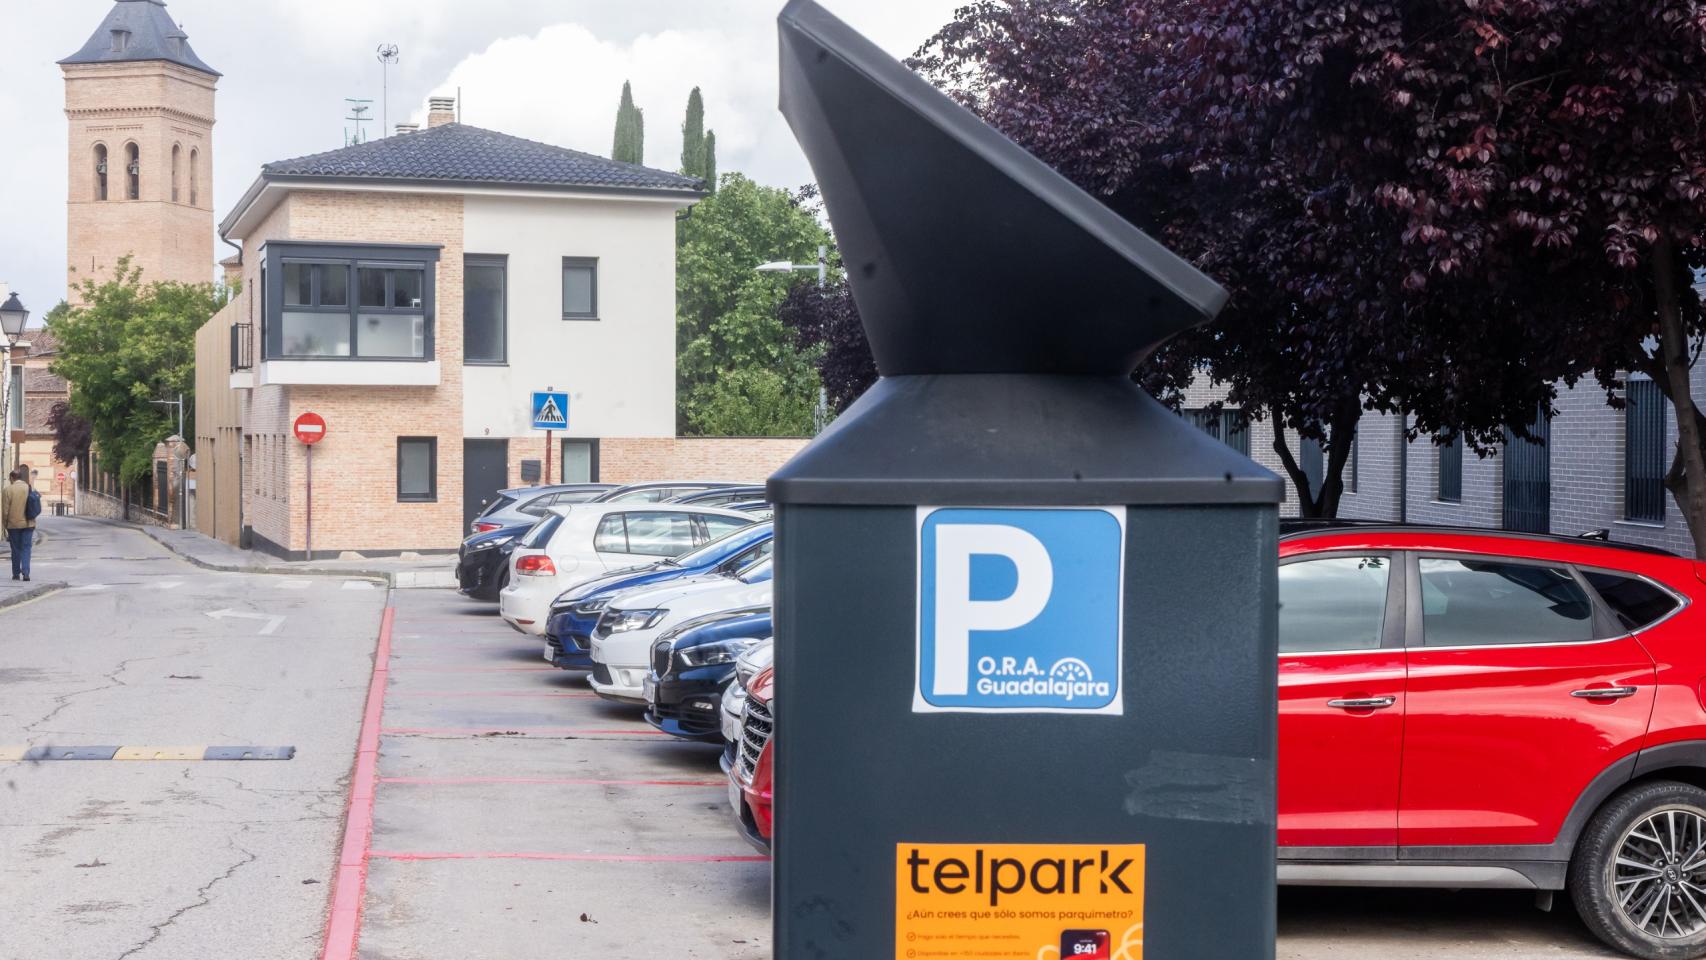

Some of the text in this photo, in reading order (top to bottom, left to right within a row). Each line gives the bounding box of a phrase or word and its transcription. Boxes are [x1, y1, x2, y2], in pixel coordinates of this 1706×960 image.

[933, 524, 1053, 695] P
[977, 656, 1046, 676] O.R.A.
[976, 677, 1110, 701] Guadalajara
[907, 849, 1135, 906] telpark
[937, 911, 967, 919] crees
[970, 911, 991, 920] que
[1019, 911, 1056, 919] somos
[1074, 943, 1097, 954] 9:41
